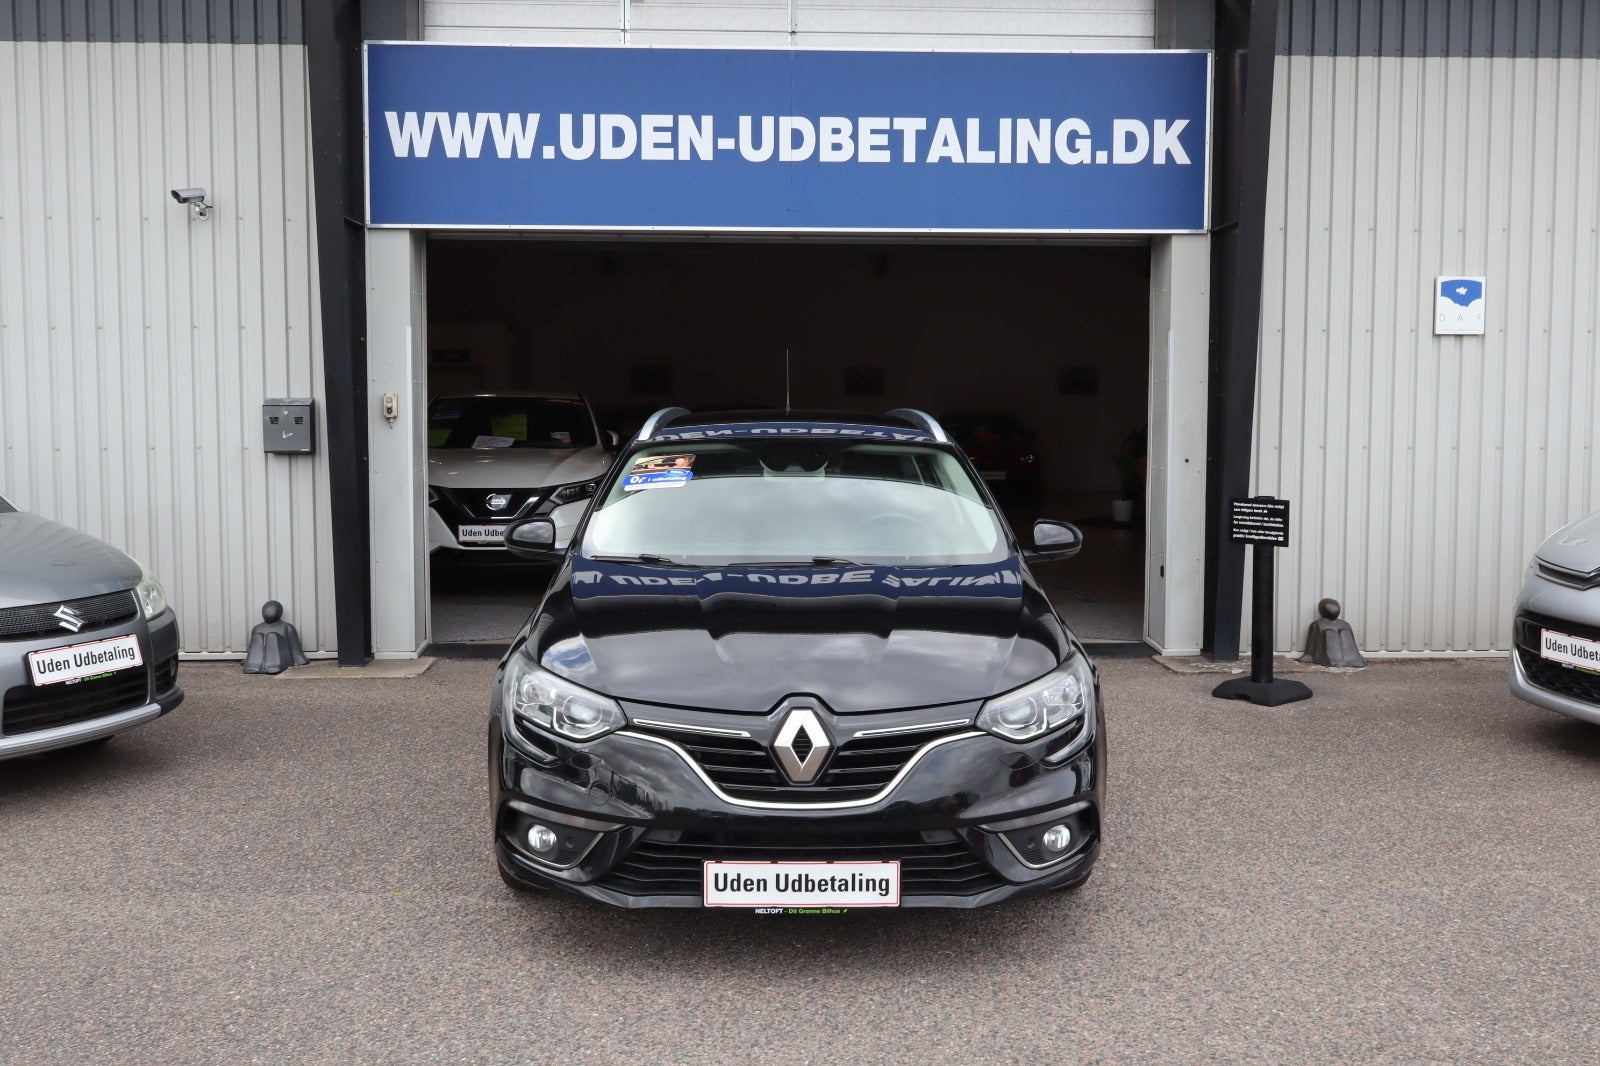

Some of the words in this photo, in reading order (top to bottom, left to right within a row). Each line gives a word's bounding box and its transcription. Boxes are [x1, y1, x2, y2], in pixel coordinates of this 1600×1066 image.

[384, 111, 1192, 165] WWW.UDEN-UDBETALING.DK
[462, 528, 482, 537] Uden
[484, 528, 505, 537] Udbe
[37, 658, 70, 674] Uden
[73, 646, 135, 667] Udbetaling
[1545, 637, 1568, 655] Uden
[1570, 643, 1600, 661] Udbet
[714, 872, 768, 892] Uden
[775, 872, 890, 897] Udbetaling
